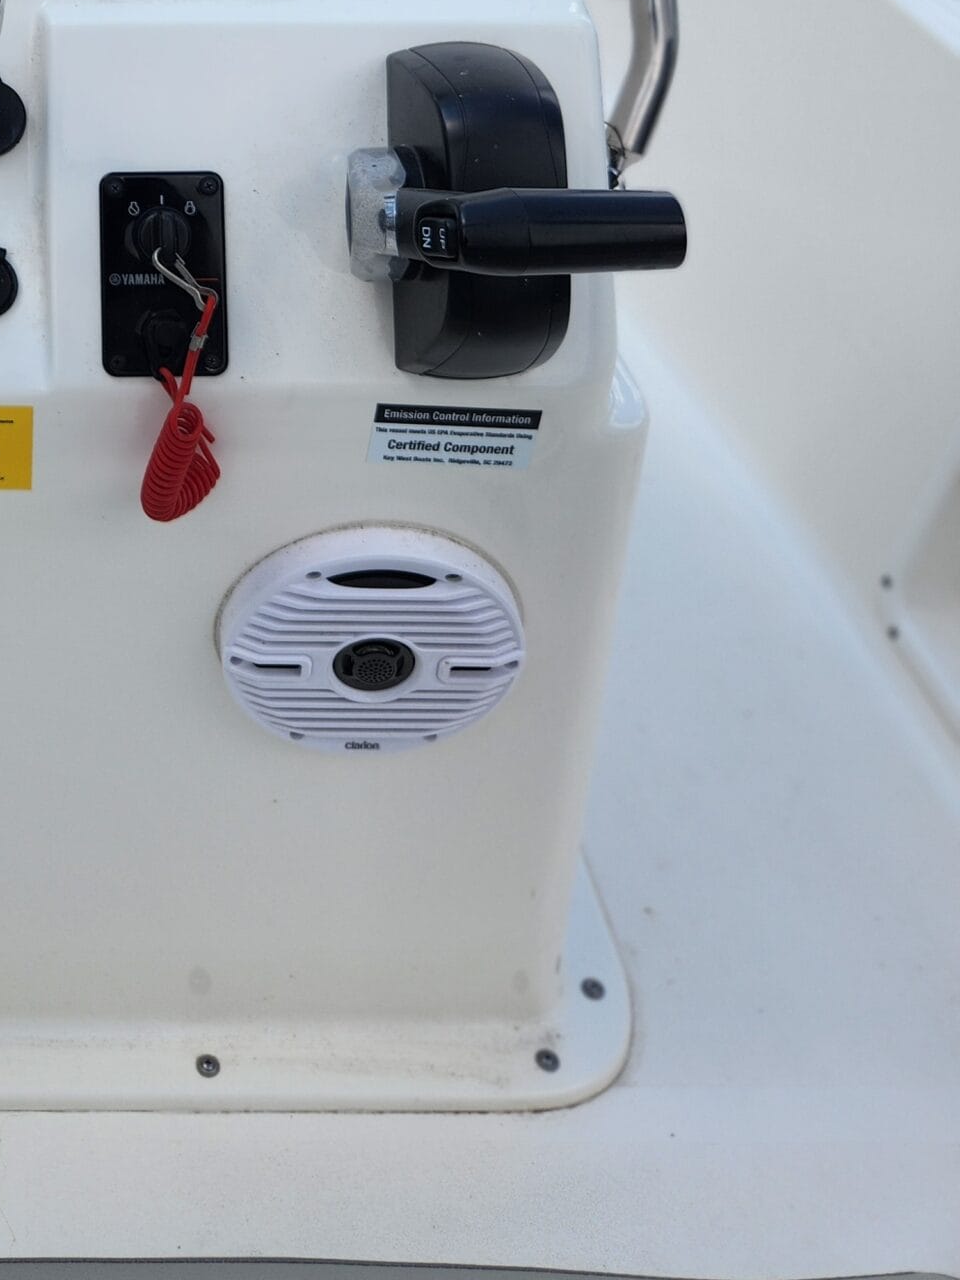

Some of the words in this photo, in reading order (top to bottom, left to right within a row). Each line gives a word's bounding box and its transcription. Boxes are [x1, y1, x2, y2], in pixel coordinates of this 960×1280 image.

[422, 226, 431, 248] DN
[122, 274, 165, 285] YAMAHA
[384, 409, 430, 420] Emission
[432, 411, 470, 422] Control
[472, 413, 532, 424] Information
[387, 439, 441, 451] Certified
[443, 442, 515, 455] Component
